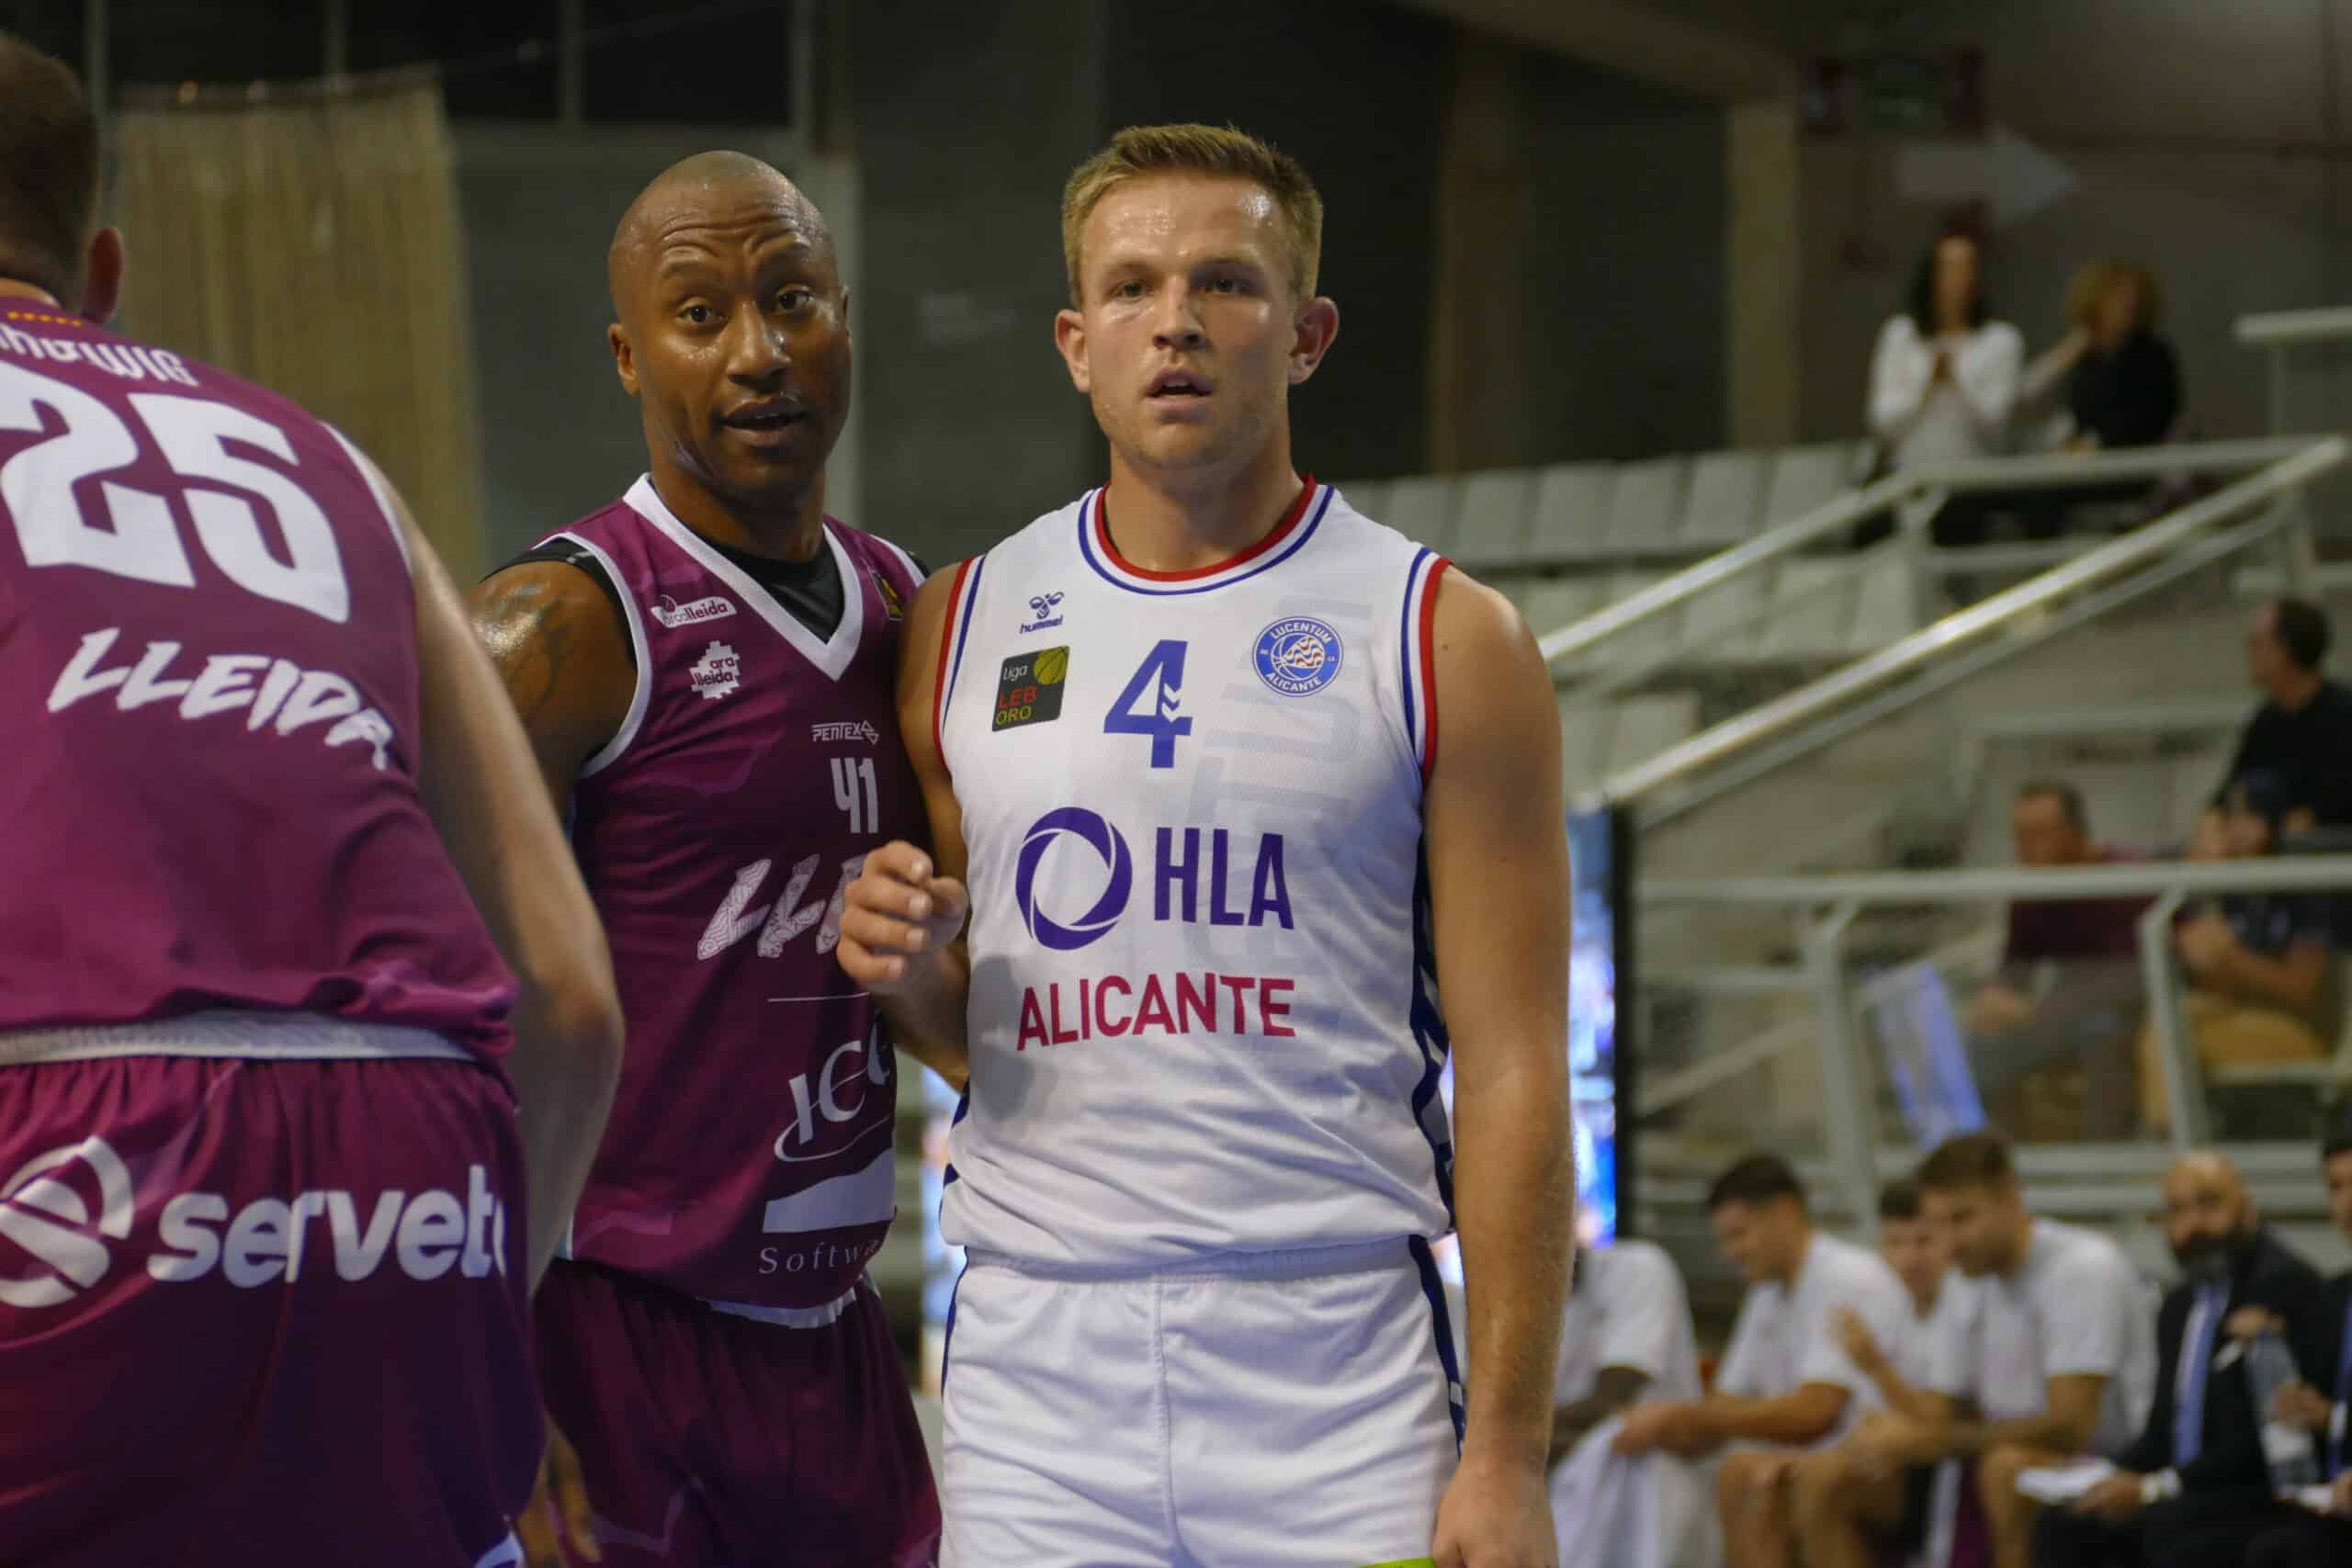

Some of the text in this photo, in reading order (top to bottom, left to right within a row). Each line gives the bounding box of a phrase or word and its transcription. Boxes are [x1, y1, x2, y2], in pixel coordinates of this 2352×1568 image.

[0, 361, 350, 623] 25
[1019, 614, 1064, 635] hummel
[1270, 622, 1332, 643] LUCENTUM
[693, 670, 733, 685] lleida
[709, 657, 736, 670] ara
[1264, 672, 1324, 692] ALICANTE
[47, 627, 394, 770] LLEIDA
[995, 705, 1032, 726] ORO
[998, 686, 1038, 710] LEB
[1102, 639, 1193, 769] 4
[830, 757, 878, 834] 41
[1154, 827, 1295, 930] HLA
[1016, 972, 1296, 1051] ALICANTE
[147, 1164, 505, 1289] servet
